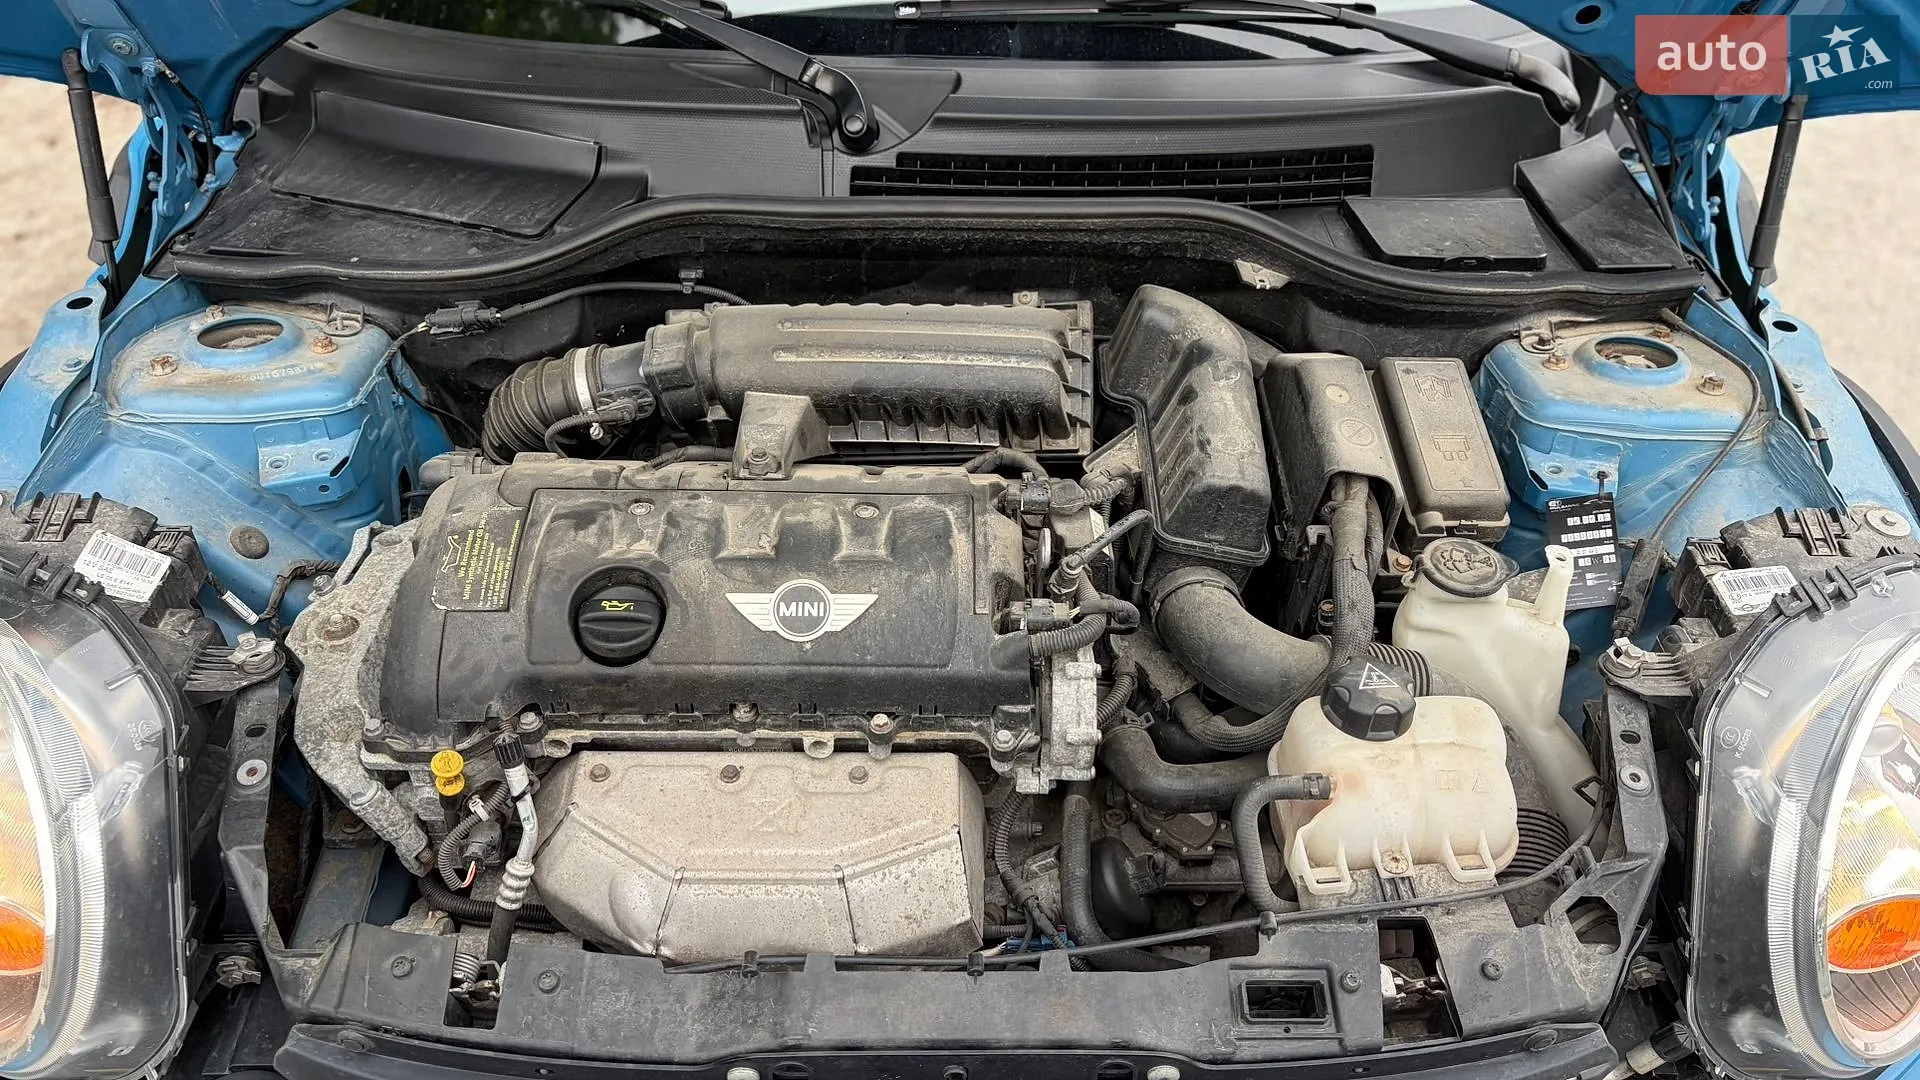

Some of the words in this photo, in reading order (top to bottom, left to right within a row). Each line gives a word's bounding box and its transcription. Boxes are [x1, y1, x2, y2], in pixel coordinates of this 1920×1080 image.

[461, 530, 474, 565] Recommend
[472, 538, 481, 554] Motor
[458, 567, 465, 576] We
[779, 601, 824, 617] MINI
